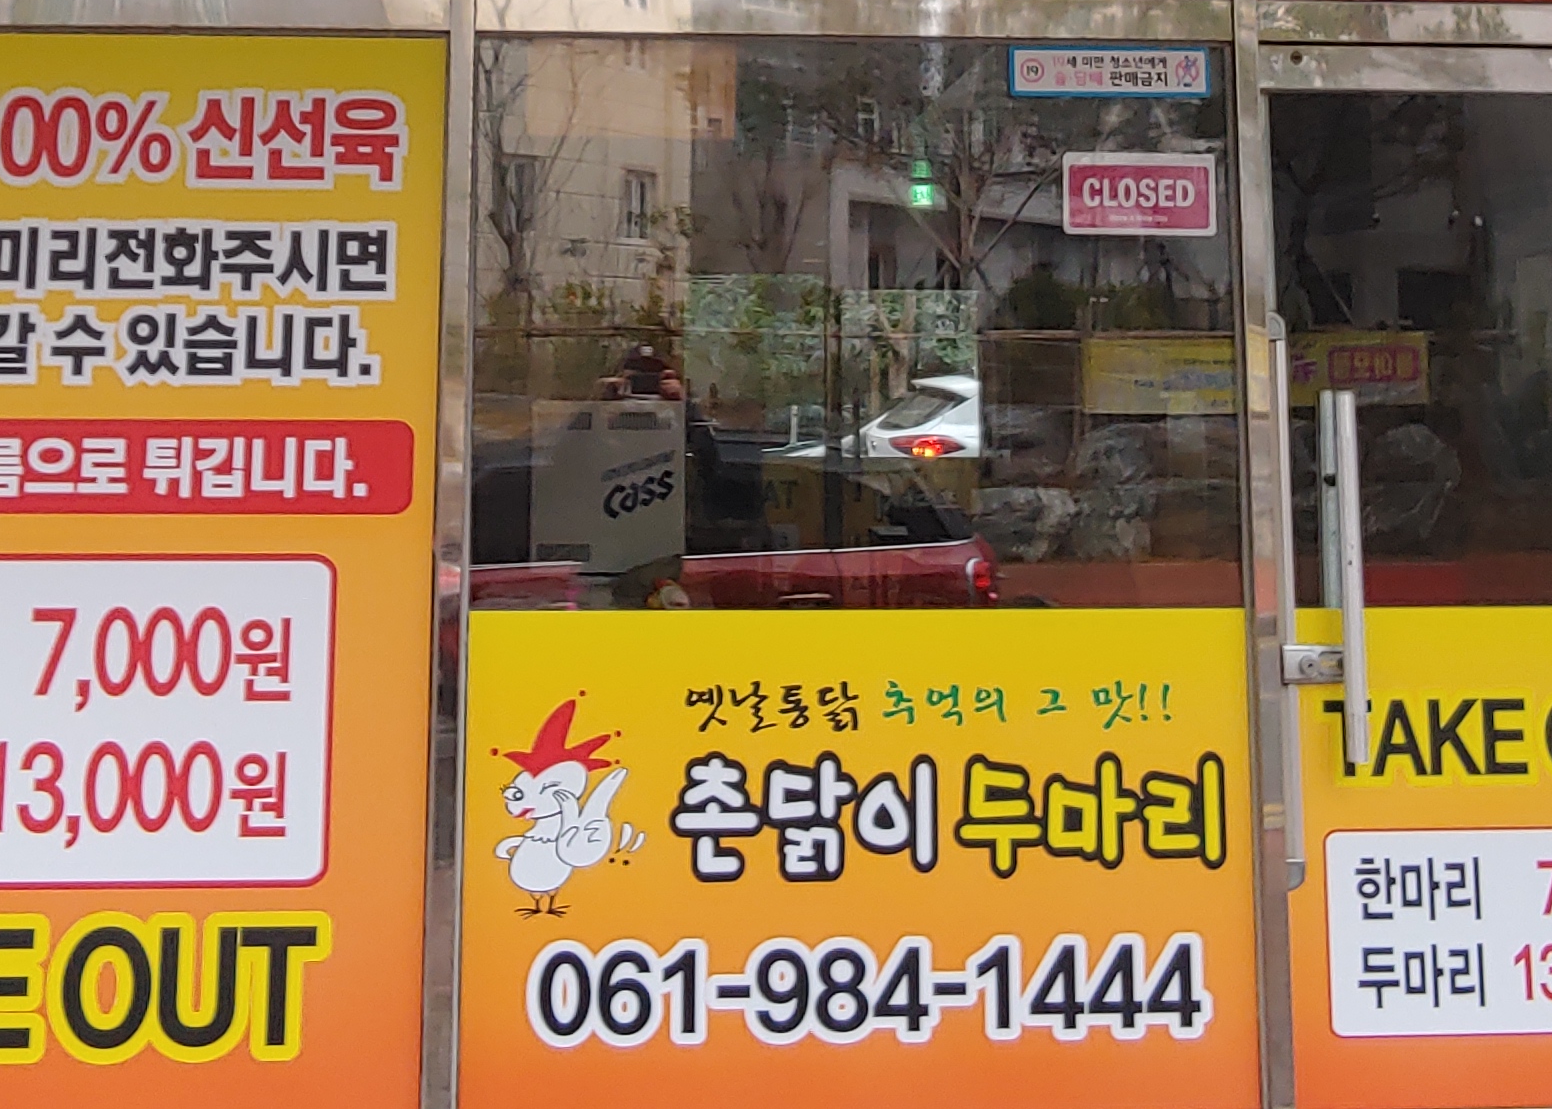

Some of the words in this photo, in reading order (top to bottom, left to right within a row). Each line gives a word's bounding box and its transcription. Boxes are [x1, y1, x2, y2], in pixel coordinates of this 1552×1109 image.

[1082, 56, 1104, 69] 미만
[1109, 55, 1168, 69] 청소년에게
[1109, 71, 1168, 87] 판매금지
[189, 95, 402, 183] 신선육
[1082, 177, 1196, 209] CLOSED
[51, 312, 107, 377] 수
[125, 312, 372, 378] 있습니다.
[143, 436, 369, 500] 튀깁니다.
[31, 605, 292, 713] 7,000원
[684, 680, 860, 733] 옛날통닭
[882, 680, 1008, 727] 추억의
[1036, 687, 1068, 716] 그
[1090, 680, 1173, 730] 맛!!
[1323, 698, 1529, 778] TAKE
[669, 751, 938, 882] 촌닭이
[956, 749, 1227, 878] 두마리
[1354, 856, 1483, 921] 한마리
[62, 925, 317, 1049] OUT
[538, 941, 1202, 1037] 061-984-1444
[1358, 942, 1486, 1010] 두마리
